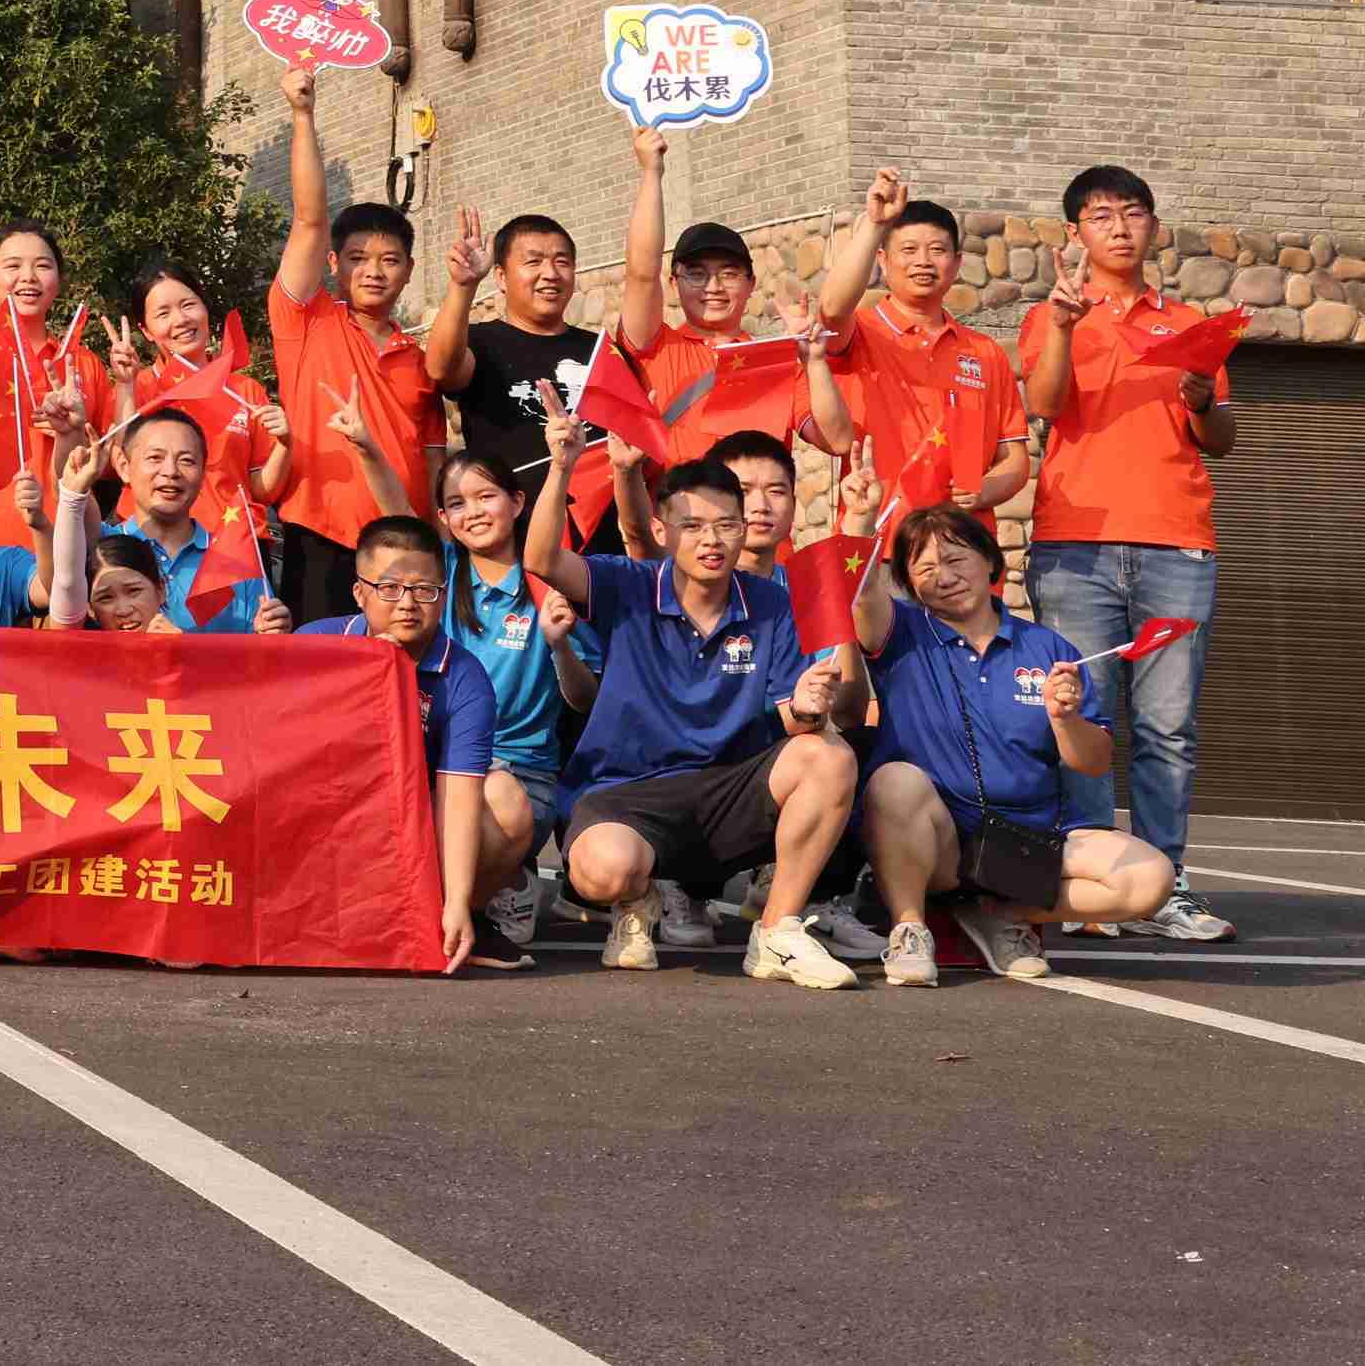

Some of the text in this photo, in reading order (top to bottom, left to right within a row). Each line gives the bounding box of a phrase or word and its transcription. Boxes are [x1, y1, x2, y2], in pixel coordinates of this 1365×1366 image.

[260, 4, 370, 57] 我醉帅
[665, 24, 718, 47] WE
[651, 50, 711, 75] ARE
[643, 75, 731, 102] 伐木累
